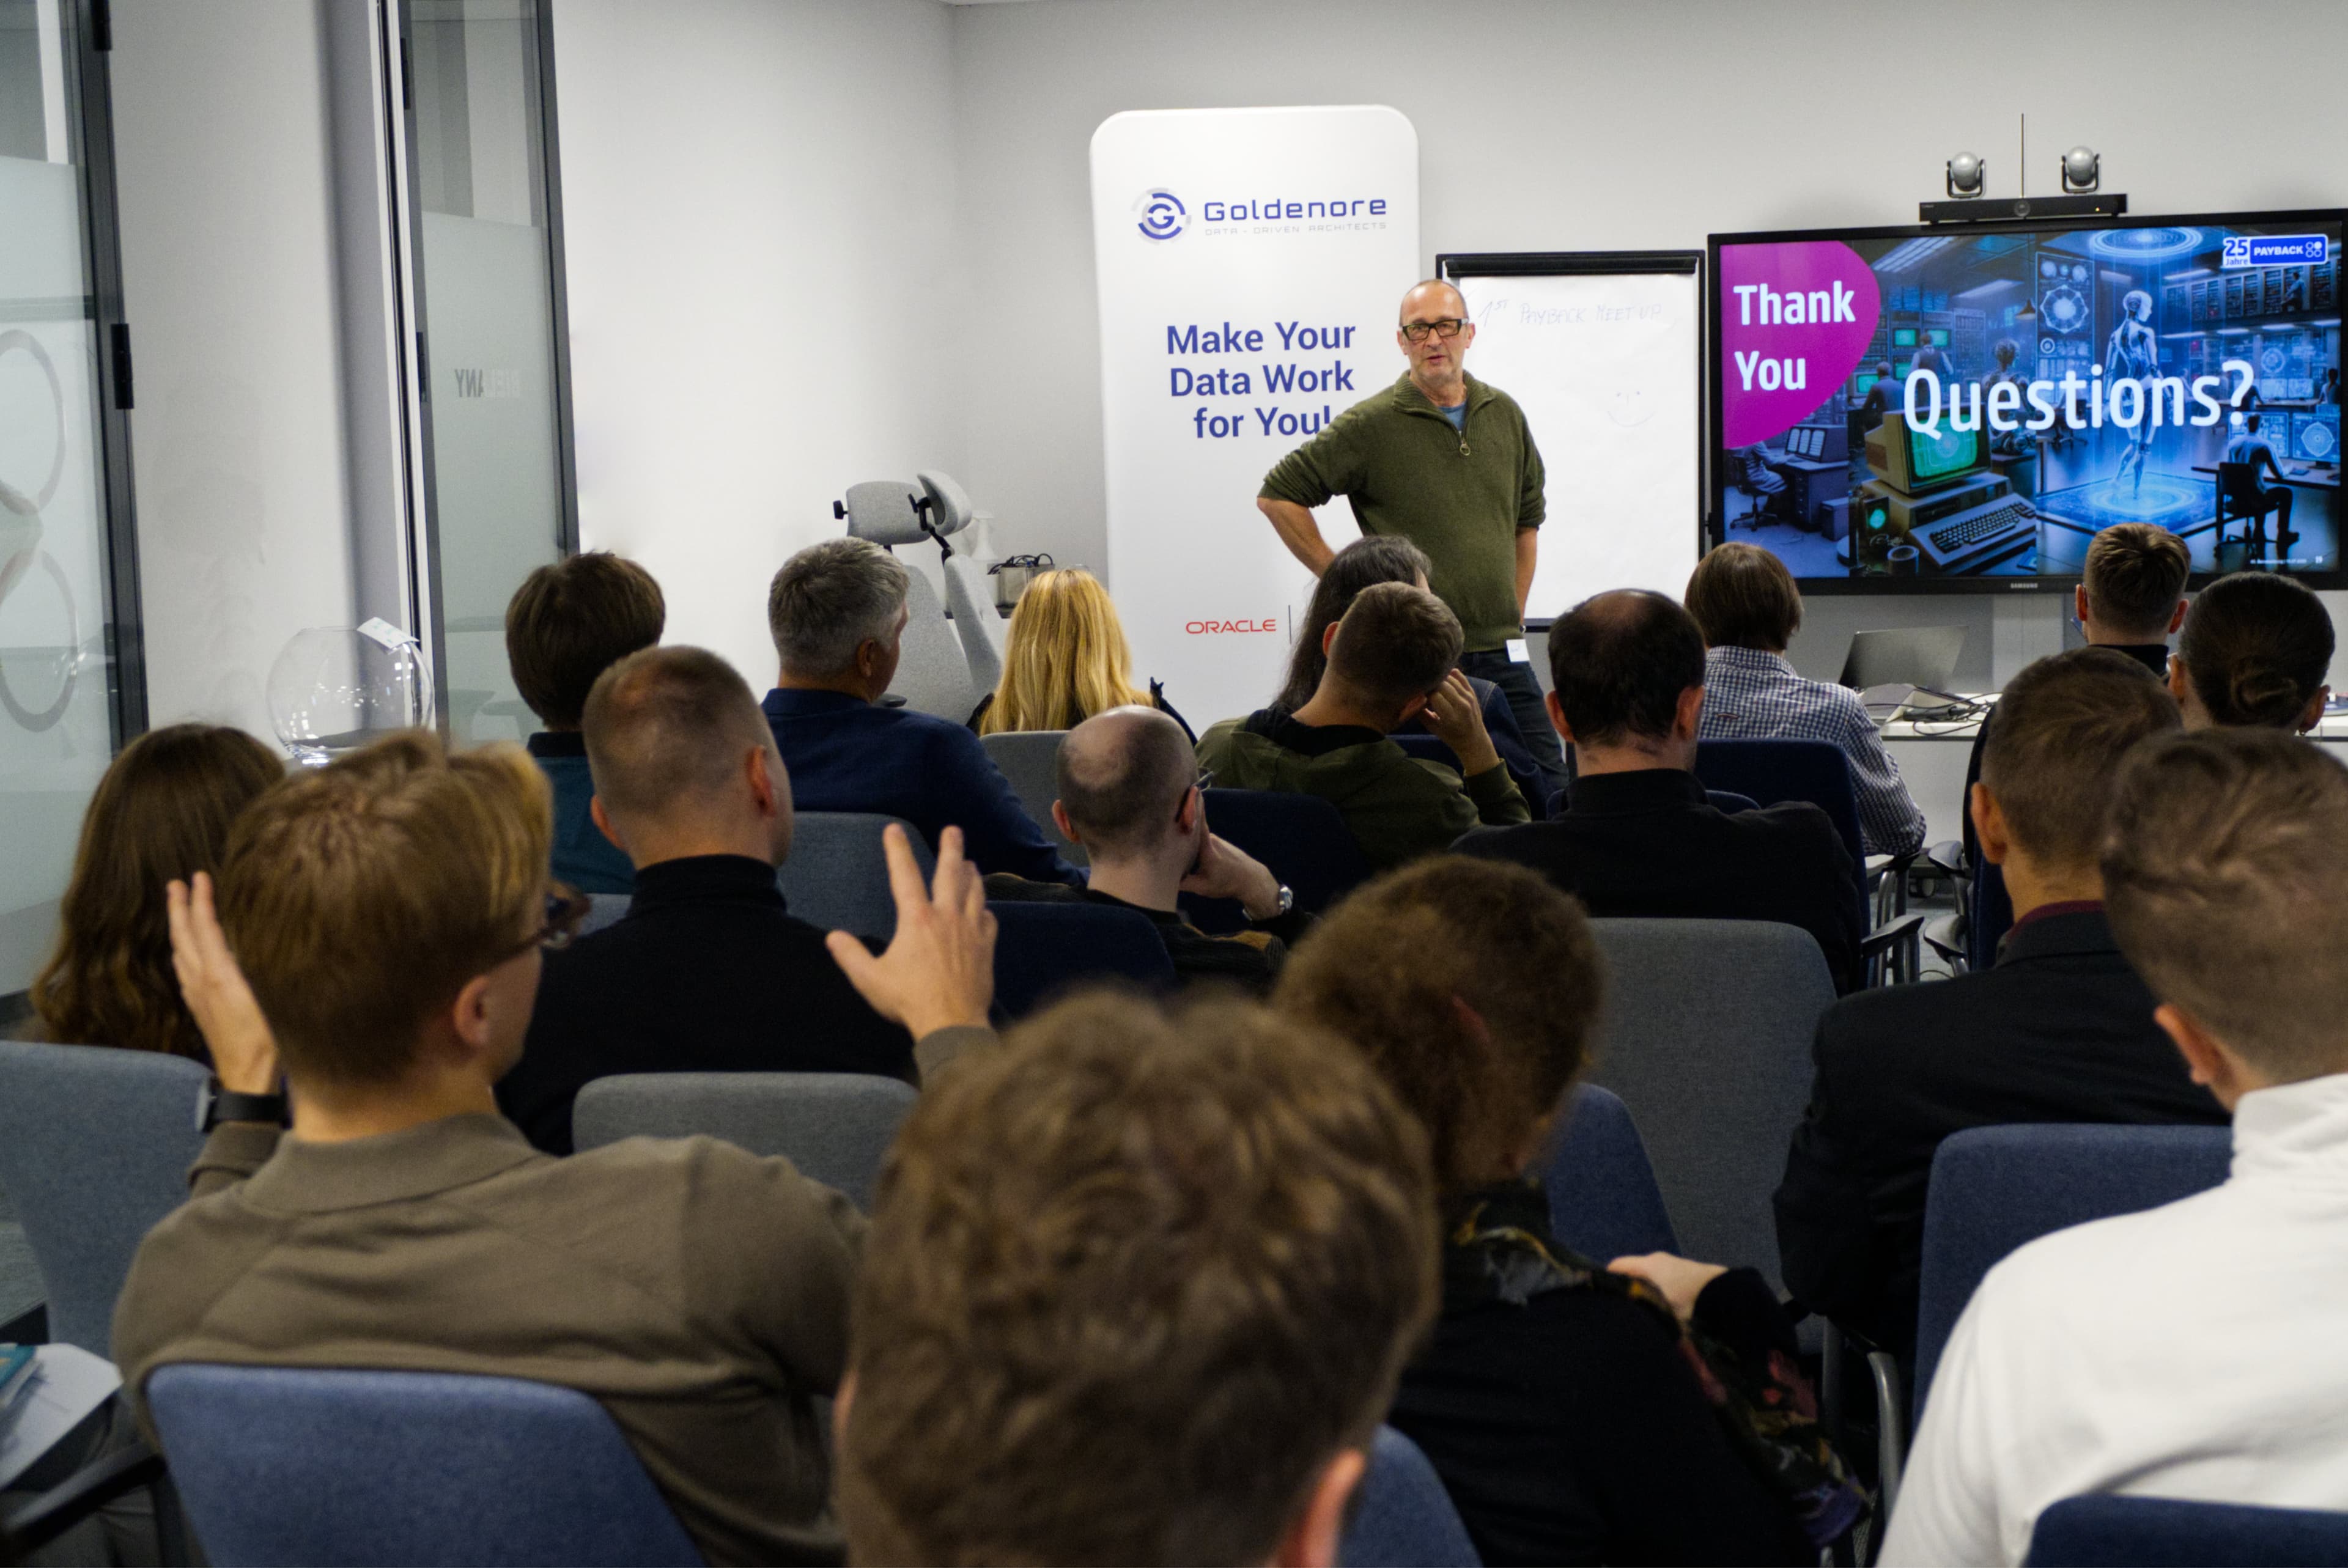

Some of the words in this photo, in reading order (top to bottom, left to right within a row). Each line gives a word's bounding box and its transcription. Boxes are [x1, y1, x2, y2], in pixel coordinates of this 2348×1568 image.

[1204, 199, 1386, 221] Goldenore
[1253, 226, 1300, 235] DRIVEN
[1308, 222, 1387, 232] ARCHITECTS
[2225, 239, 2248, 257] 25
[2253, 246, 2303, 256] PAYBACK
[1520, 303, 1587, 325] PAYBACK
[1733, 280, 1856, 325] Thank
[1167, 322, 1263, 355] Make
[1274, 321, 1356, 351] Your
[1170, 367, 1251, 397] Data
[1263, 360, 1355, 393] Work
[1734, 350, 1806, 391] You
[1904, 359, 2254, 440] Questions?
[1194, 407, 1244, 438] for
[1186, 619, 1277, 634] ORACLE
